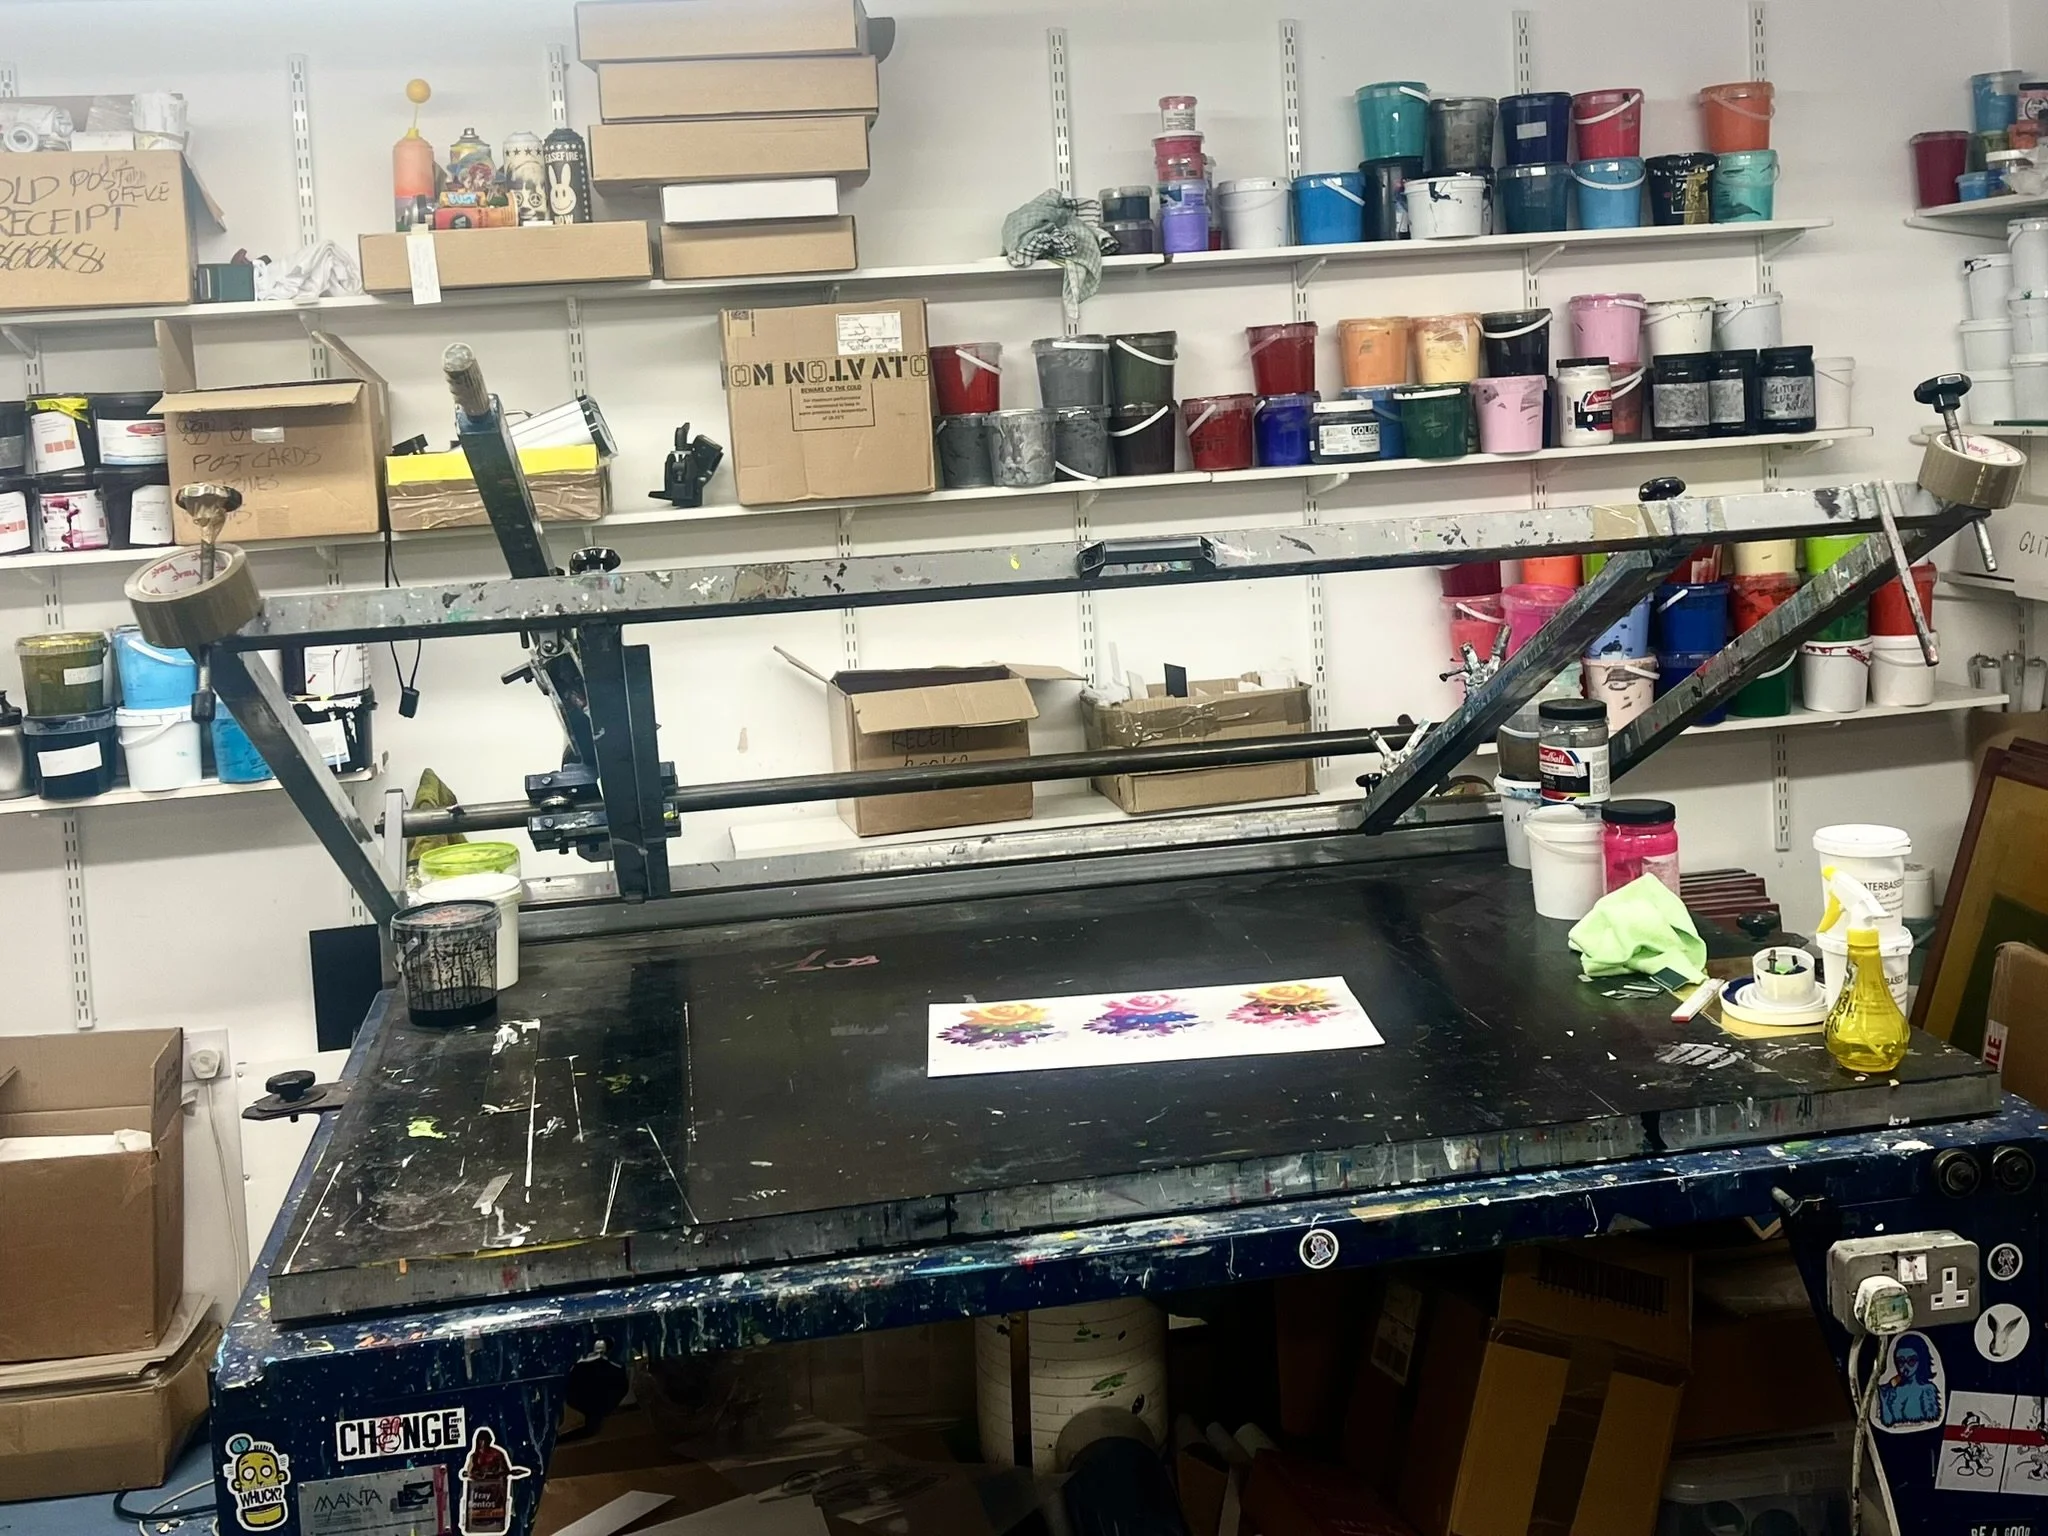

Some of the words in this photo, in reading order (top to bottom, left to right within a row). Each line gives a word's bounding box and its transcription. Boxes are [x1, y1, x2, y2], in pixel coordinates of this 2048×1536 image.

[545, 151, 579, 163] EASEFIRE
[0, 203, 138, 237] RECEIPT
[1862, 878, 1904, 891] ATERBASED
[240, 1487, 283, 1508] WHUCK?
